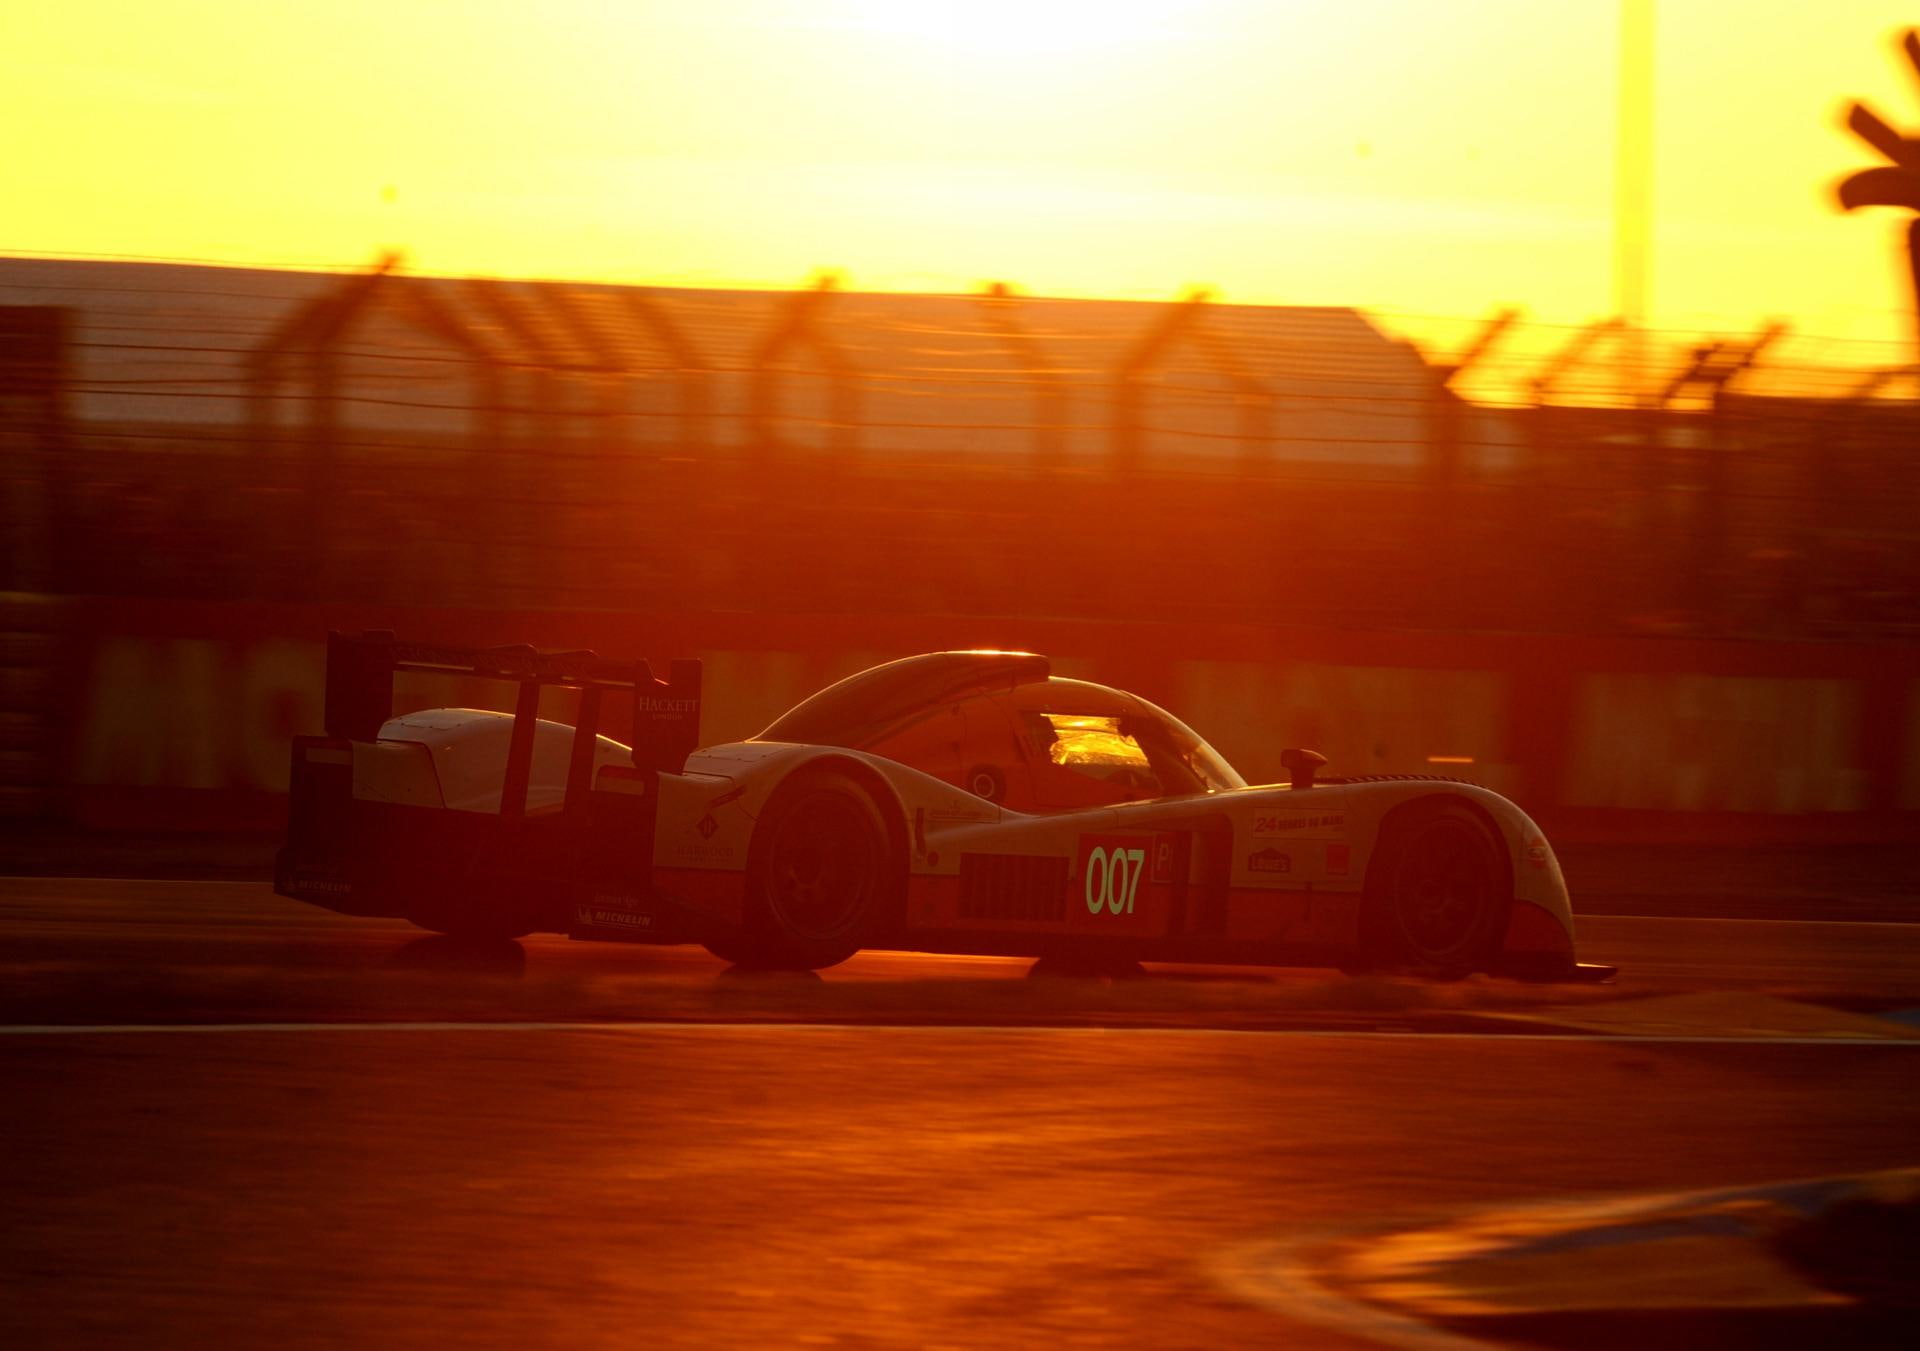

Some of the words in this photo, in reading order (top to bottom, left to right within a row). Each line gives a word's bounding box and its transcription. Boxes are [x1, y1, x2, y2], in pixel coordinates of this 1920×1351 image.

[640, 695, 699, 712] HACKETT
[1254, 817, 1276, 832] 24
[1085, 845, 1145, 915] 007
[594, 911, 652, 928] MICHELIN
